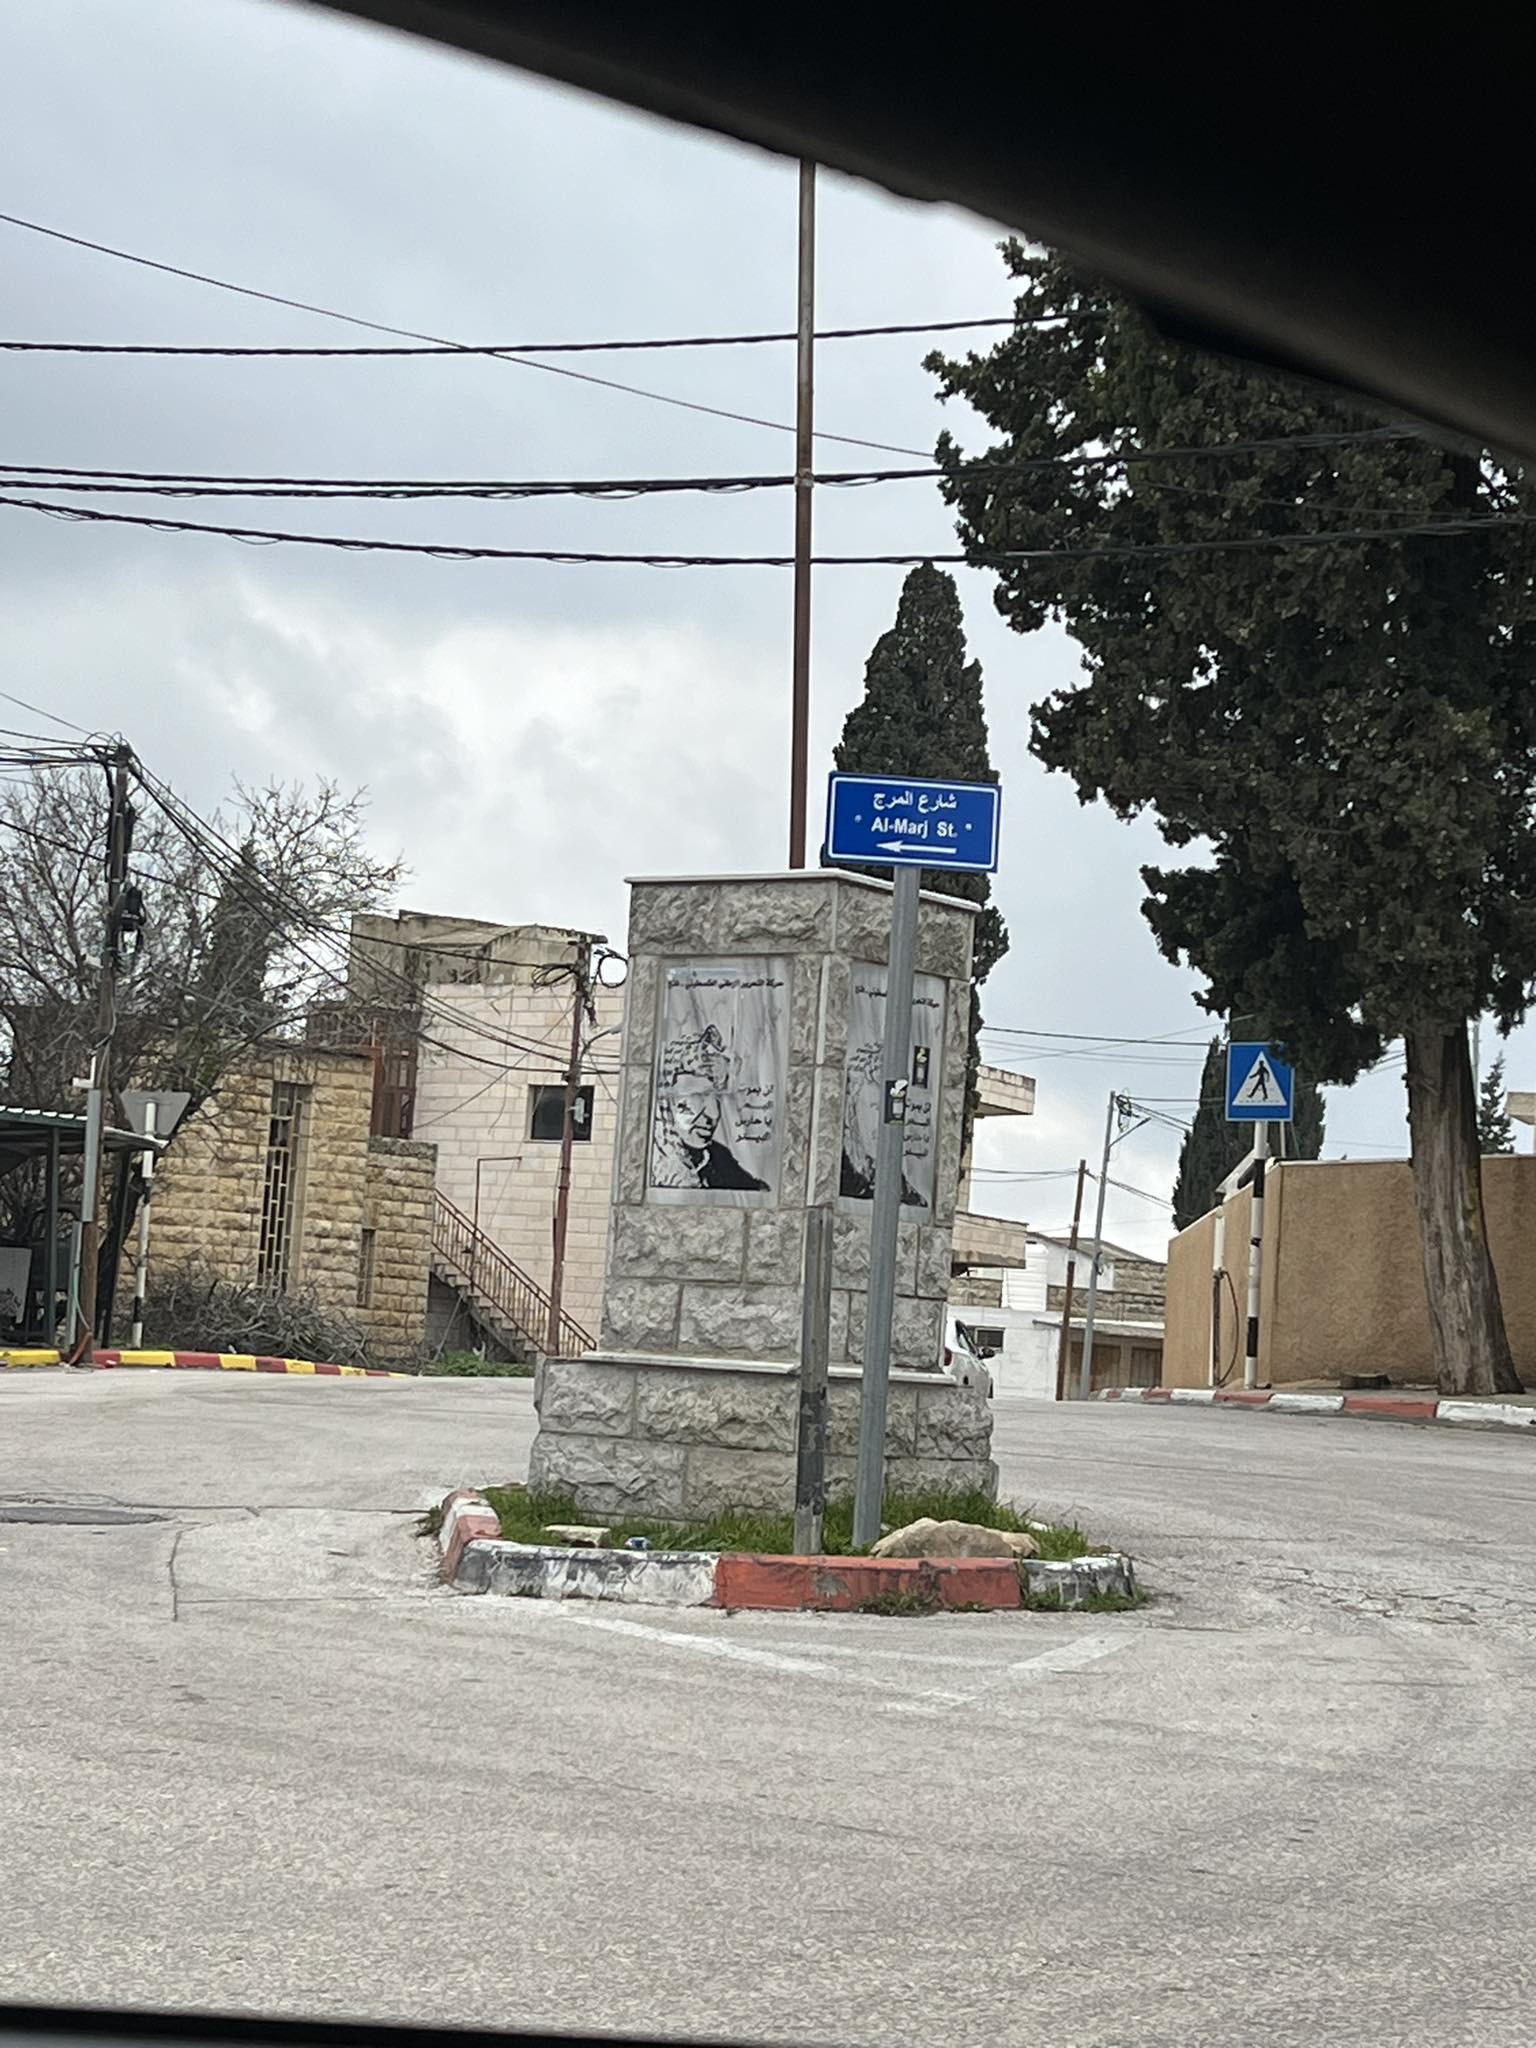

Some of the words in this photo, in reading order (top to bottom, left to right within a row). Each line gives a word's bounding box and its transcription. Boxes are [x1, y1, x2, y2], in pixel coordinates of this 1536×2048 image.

[873, 790, 913, 811] المرج
[917, 793, 957, 813] شارع
[871, 816, 928, 839] Al-Marj
[936, 821, 958, 838] St.
